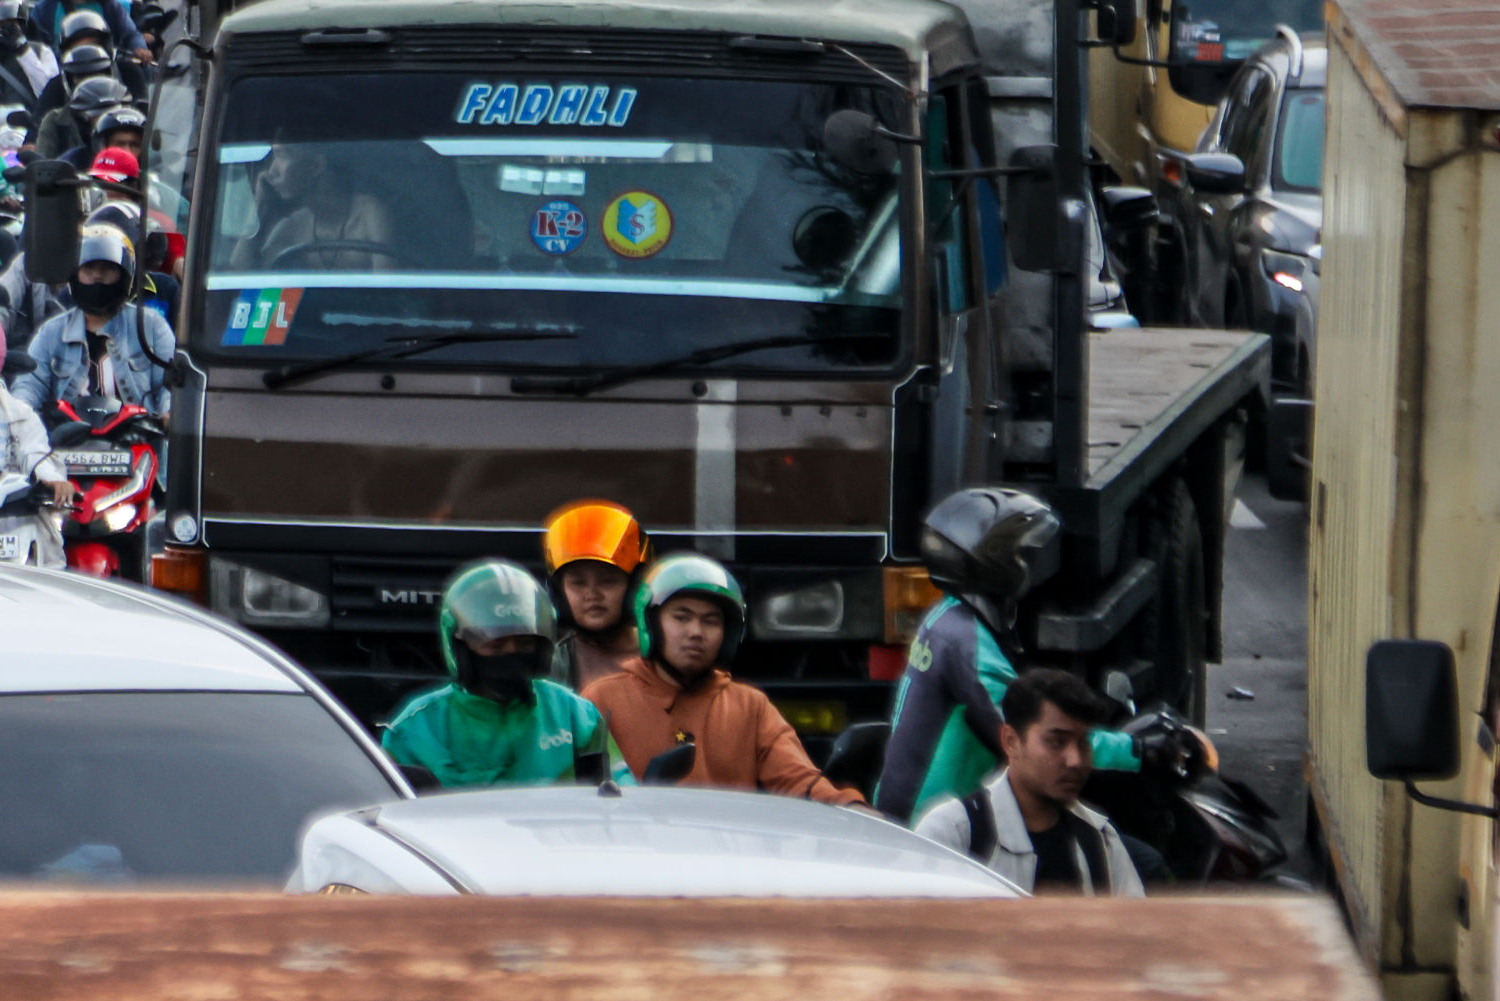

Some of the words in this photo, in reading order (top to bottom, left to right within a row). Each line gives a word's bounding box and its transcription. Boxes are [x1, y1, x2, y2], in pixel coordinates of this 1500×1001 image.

[456, 83, 638, 128] FADHLI
[535, 210, 583, 238] K-2
[545, 238, 569, 252] CV
